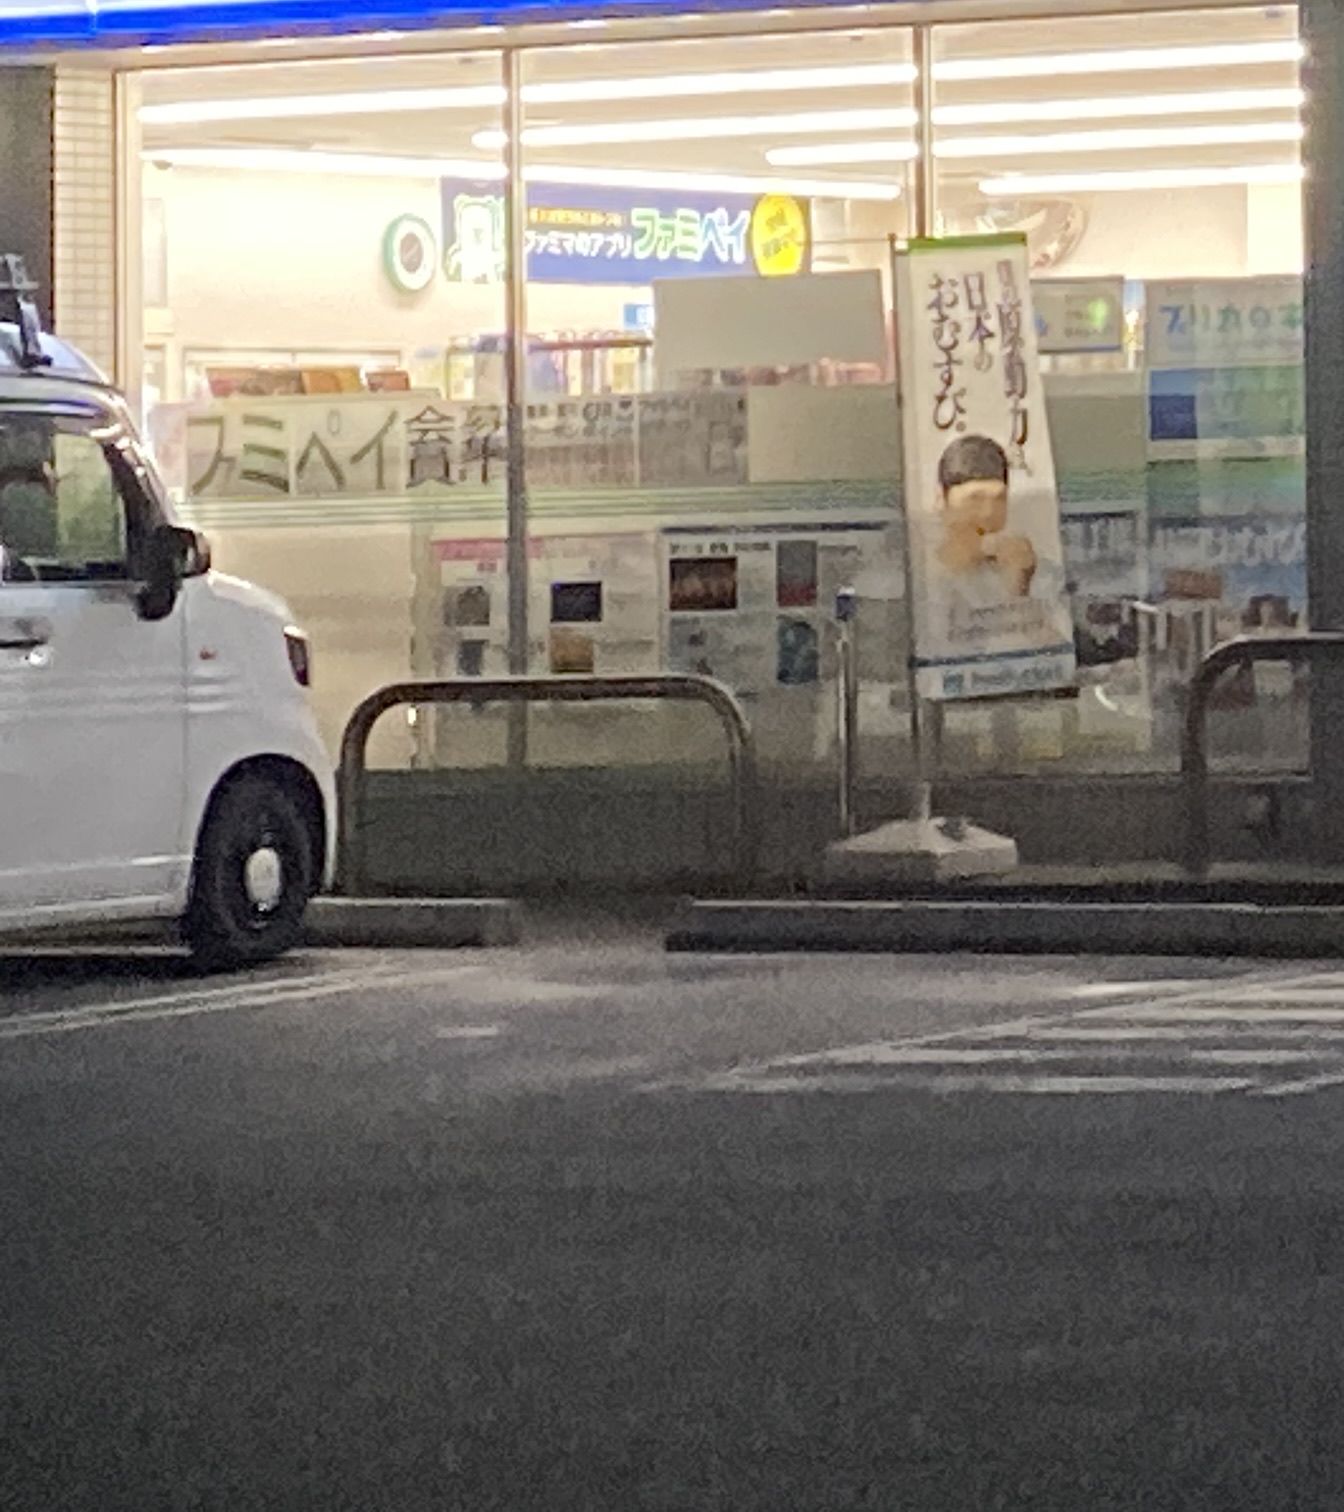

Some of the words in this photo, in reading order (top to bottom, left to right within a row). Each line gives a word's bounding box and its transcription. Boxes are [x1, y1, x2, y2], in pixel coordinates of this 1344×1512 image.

[632, 208, 750, 263] ファミペイ
